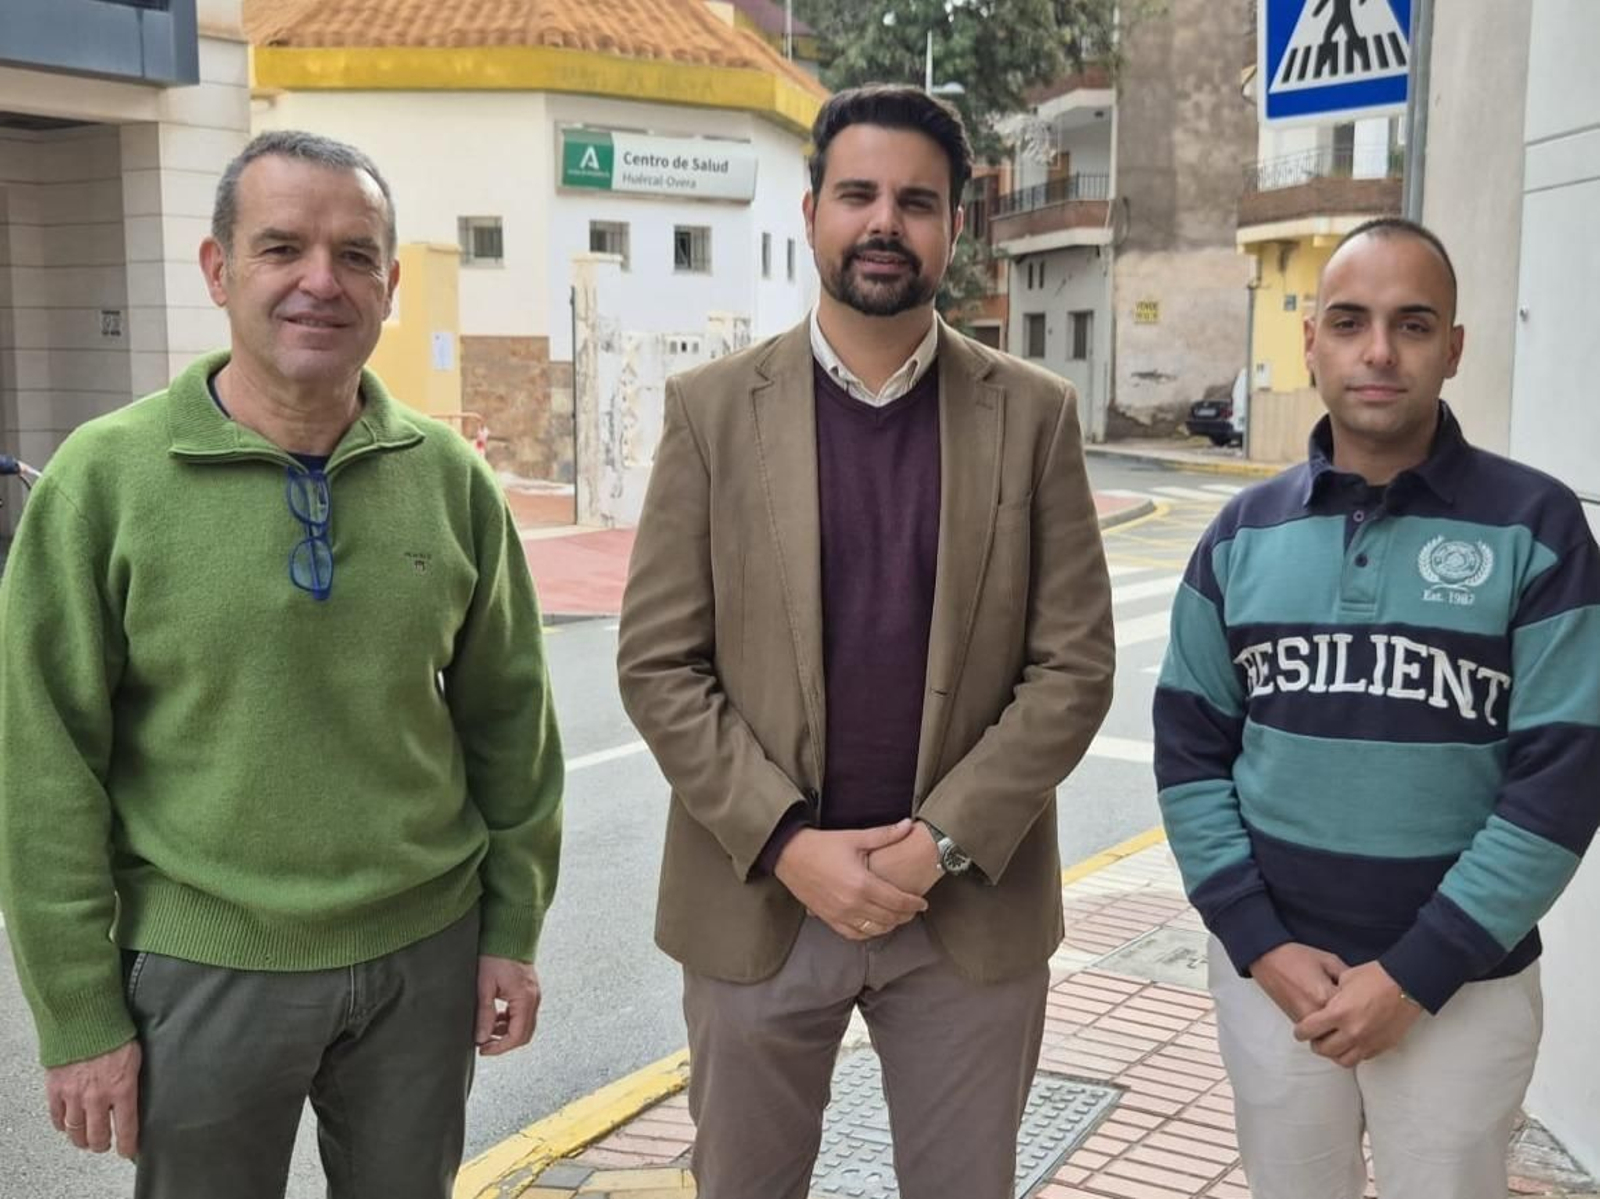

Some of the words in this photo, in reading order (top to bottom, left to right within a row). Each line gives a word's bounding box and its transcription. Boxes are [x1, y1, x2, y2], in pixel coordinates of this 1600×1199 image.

[623, 151, 669, 168] Centro
[672, 156, 689, 170] de
[692, 158, 729, 173] Salud
[1233, 633, 1511, 726] RESILIENT
